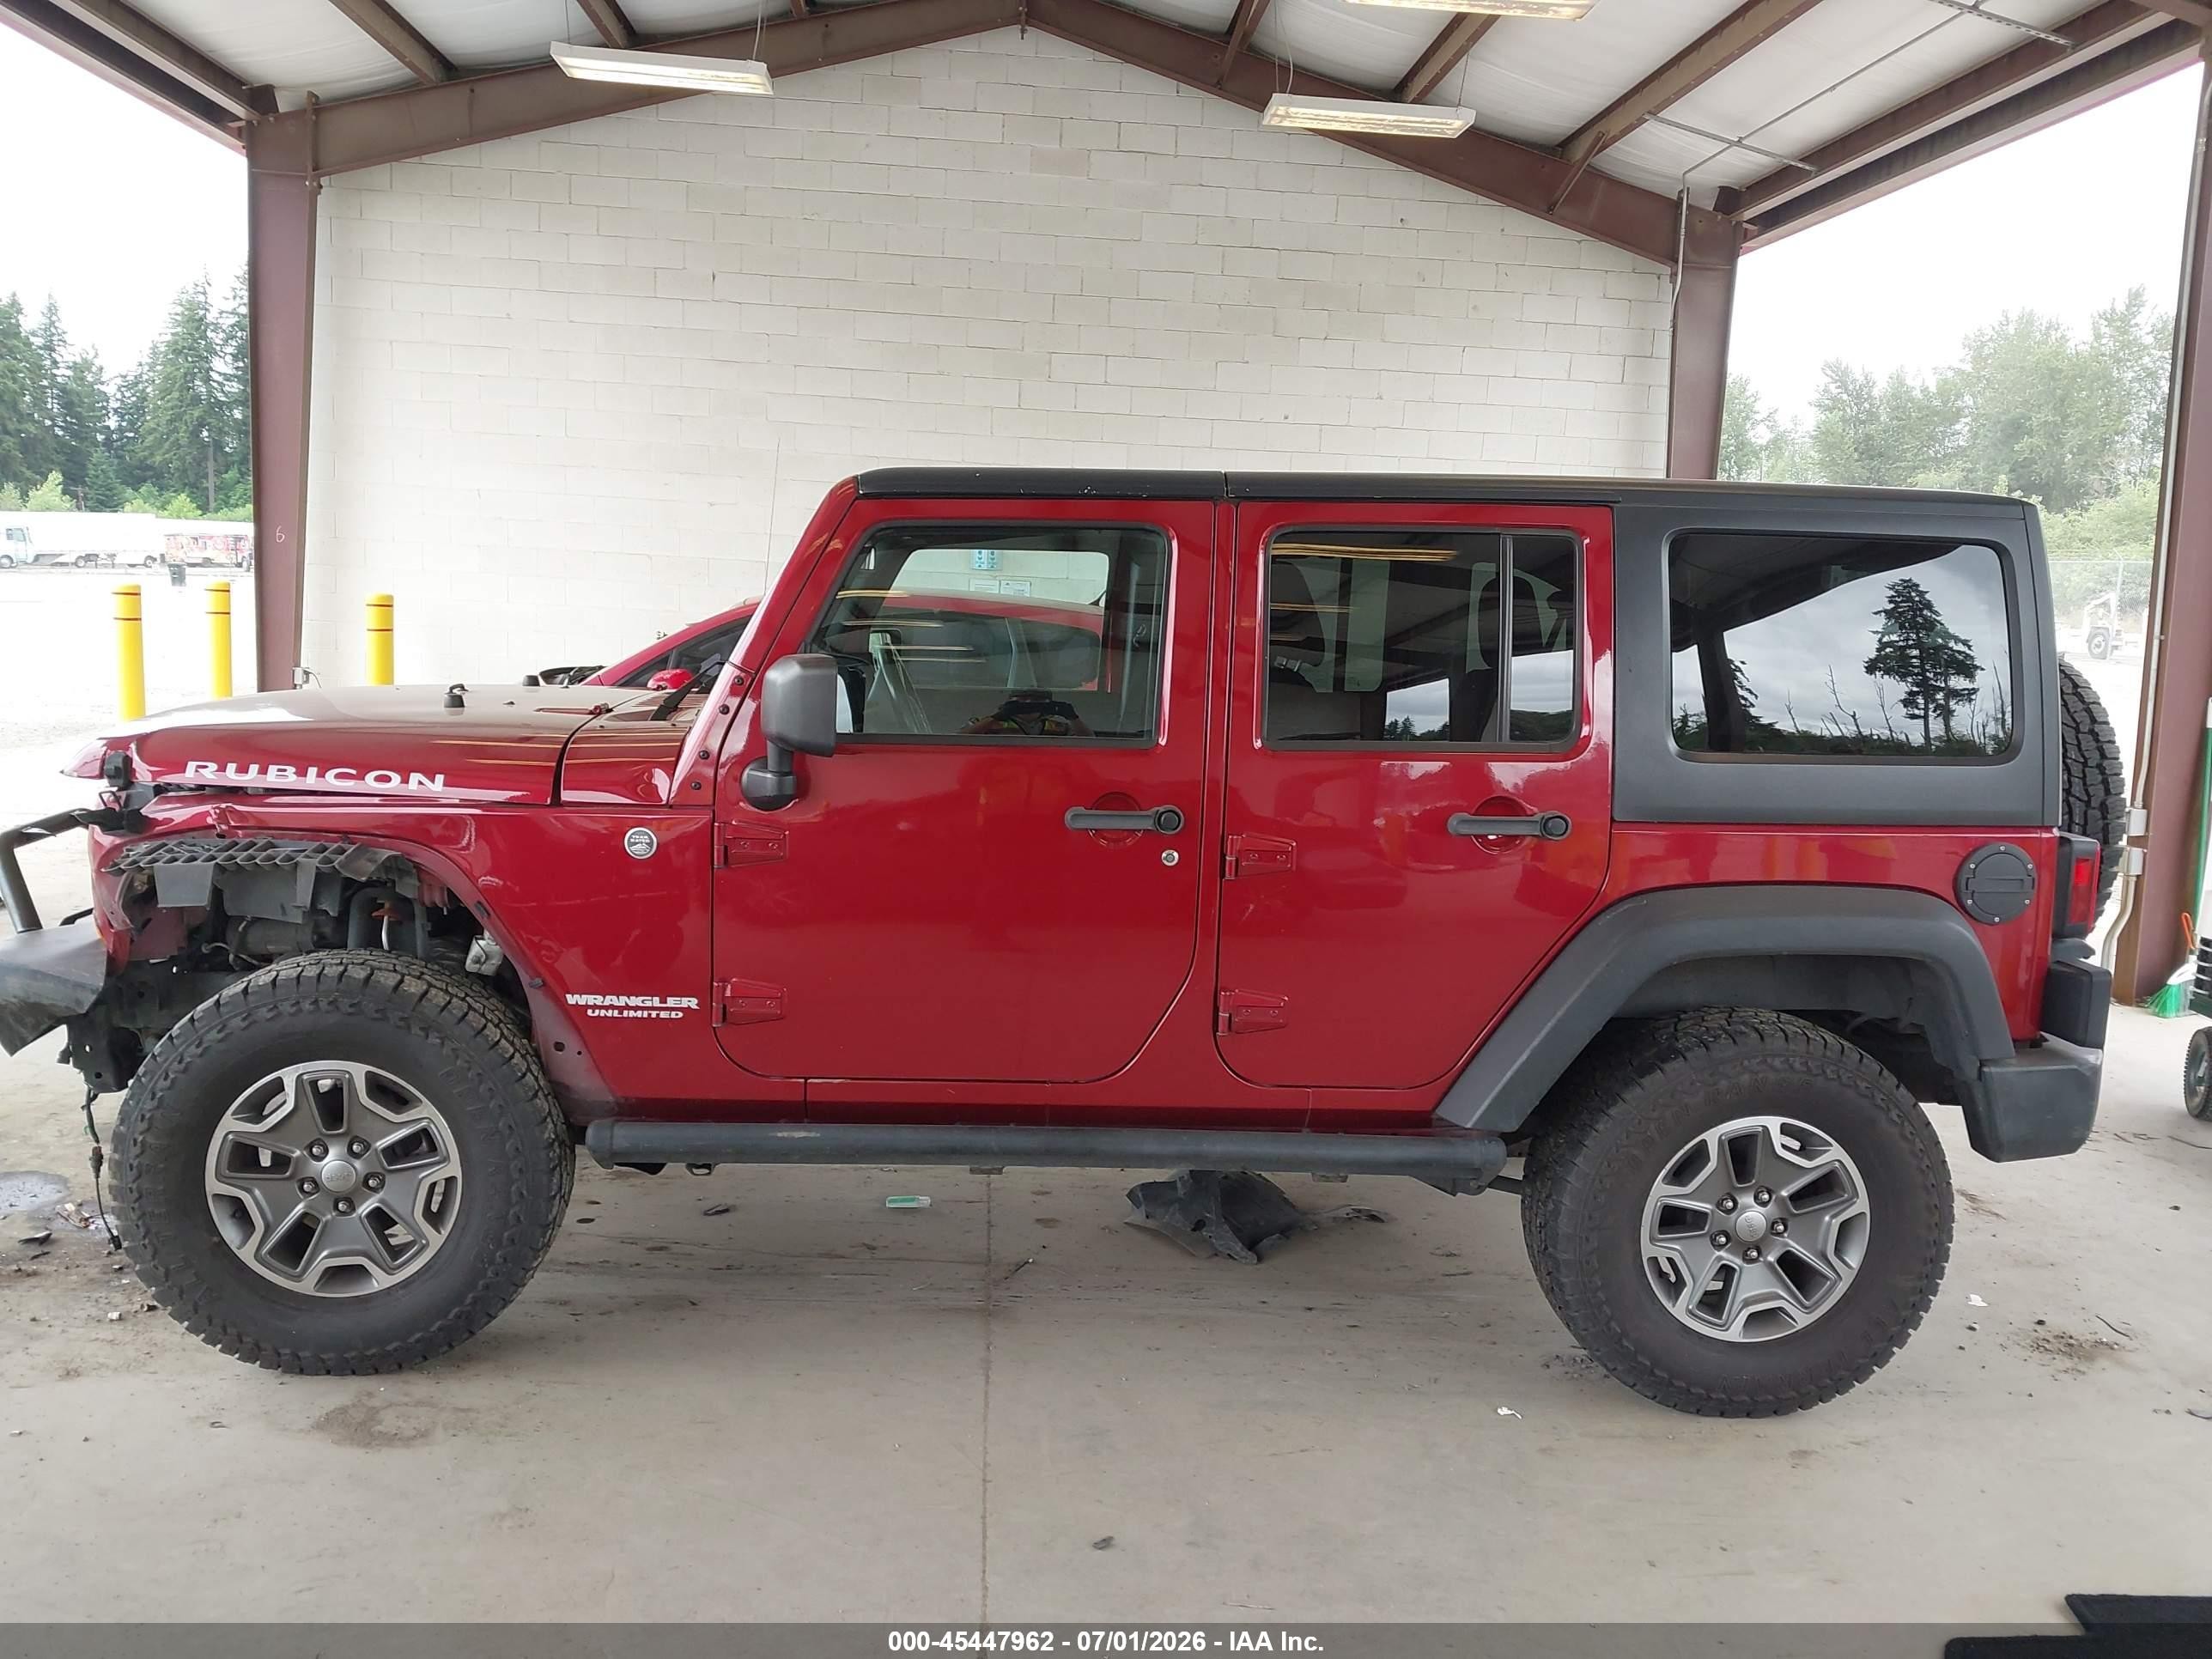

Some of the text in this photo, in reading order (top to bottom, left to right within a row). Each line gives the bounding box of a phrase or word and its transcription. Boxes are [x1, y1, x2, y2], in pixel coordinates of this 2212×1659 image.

[276, 526, 285, 543] 6
[185, 761, 445, 792] RUBICON
[565, 994, 700, 1010] WRANGLER
[586, 1009, 684, 1018] UNLIMITED
